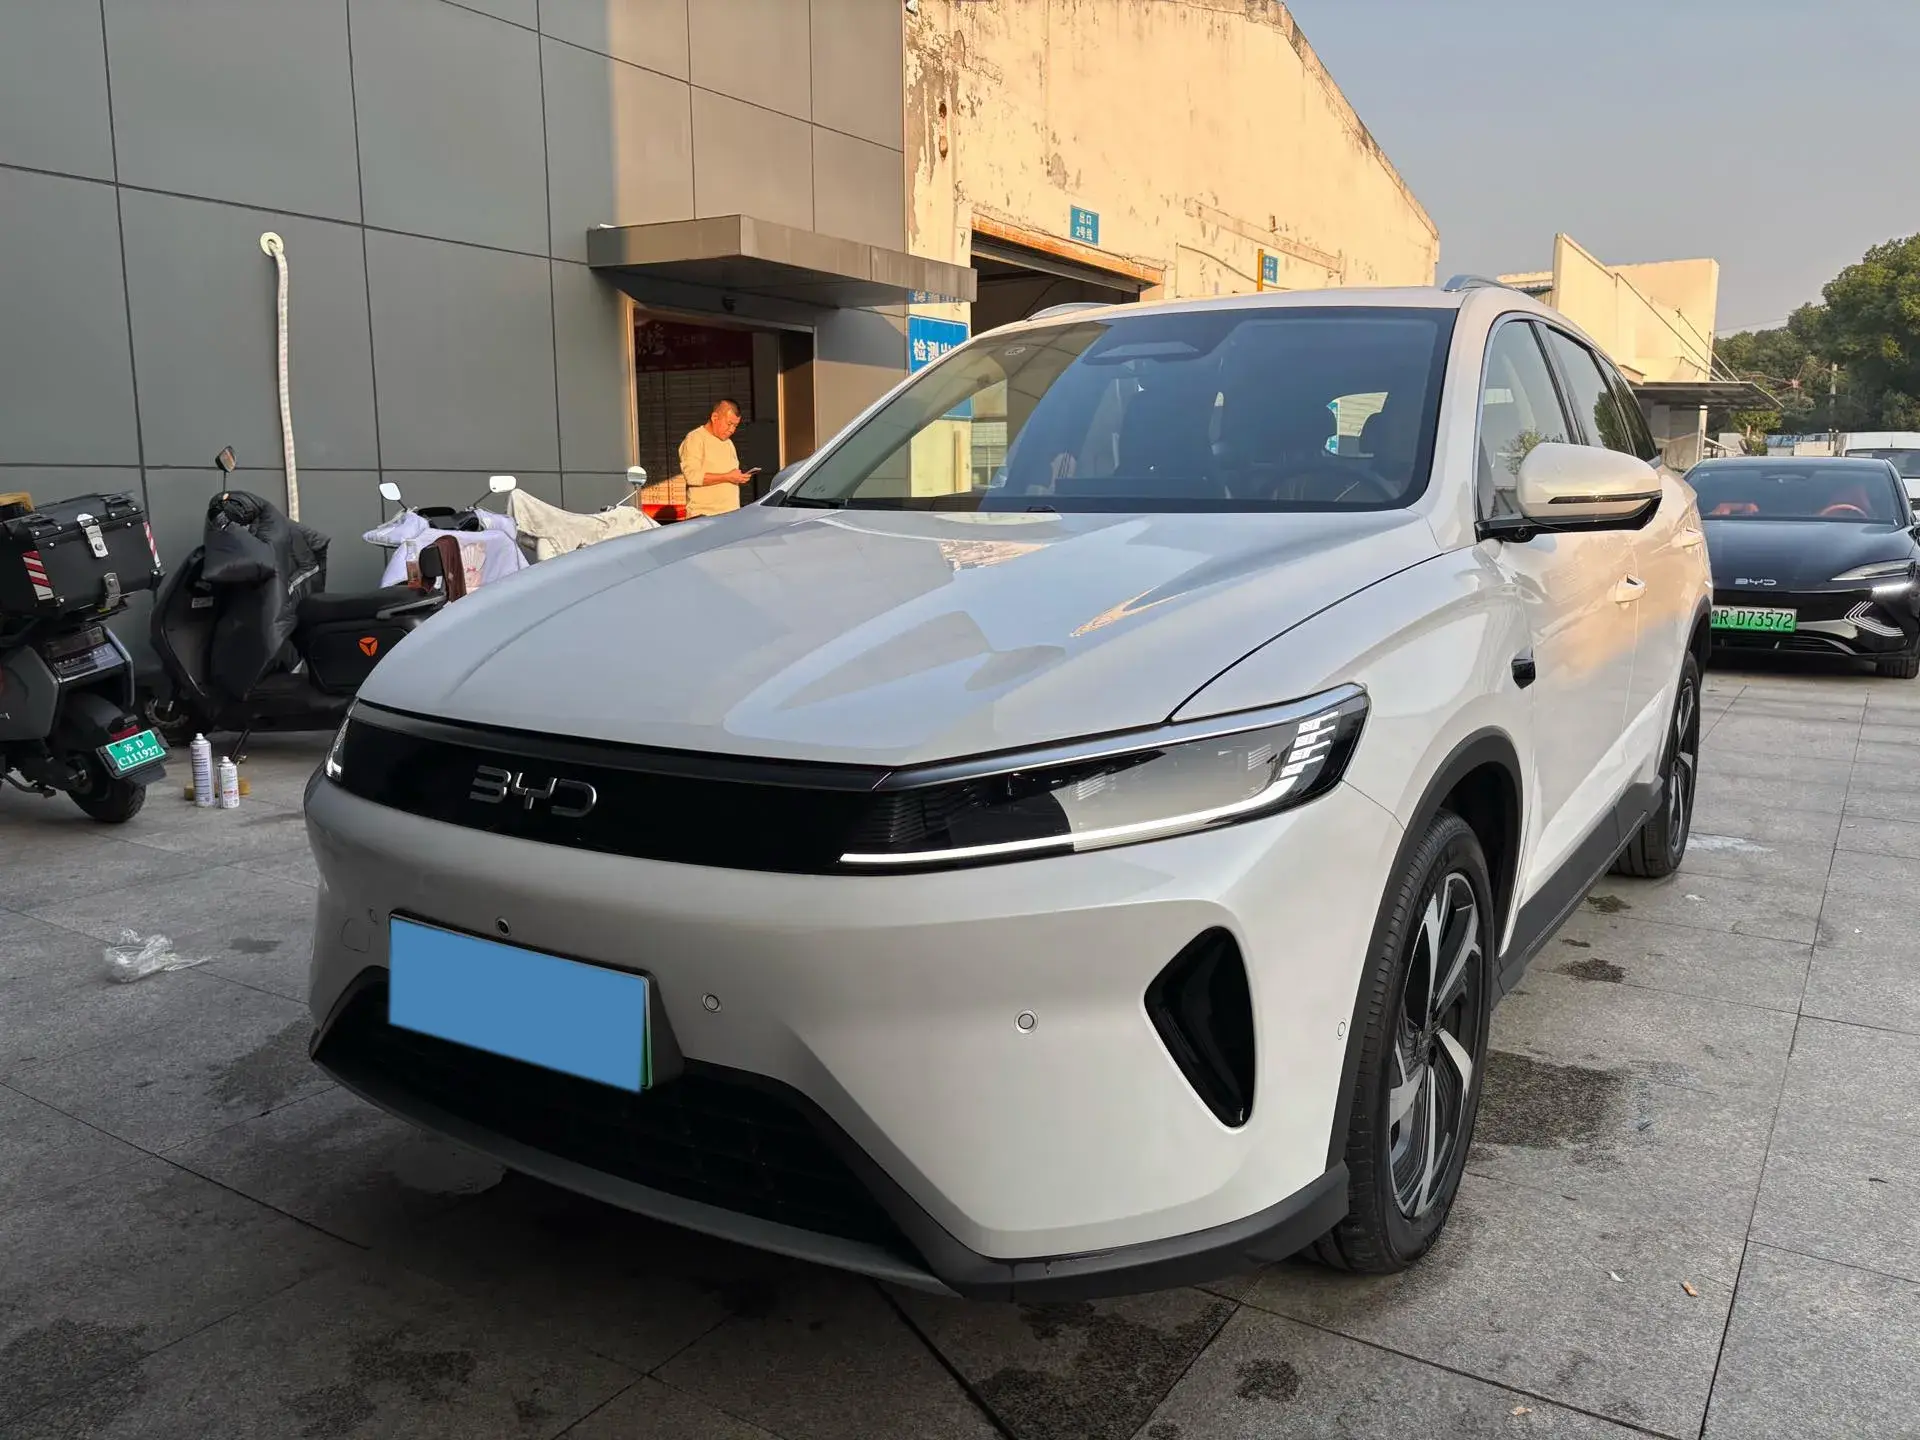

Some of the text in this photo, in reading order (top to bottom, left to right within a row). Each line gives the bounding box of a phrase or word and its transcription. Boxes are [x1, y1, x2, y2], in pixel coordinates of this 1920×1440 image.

[1079, 211, 1092, 226] 出口
[1075, 226, 1093, 241] 2号线
[913, 338, 957, 362] 检测出
[1735, 578, 1777, 586] BYD
[1736, 611, 1794, 629] D73572
[118, 745, 159, 766] C111927
[469, 765, 598, 818] BYD
